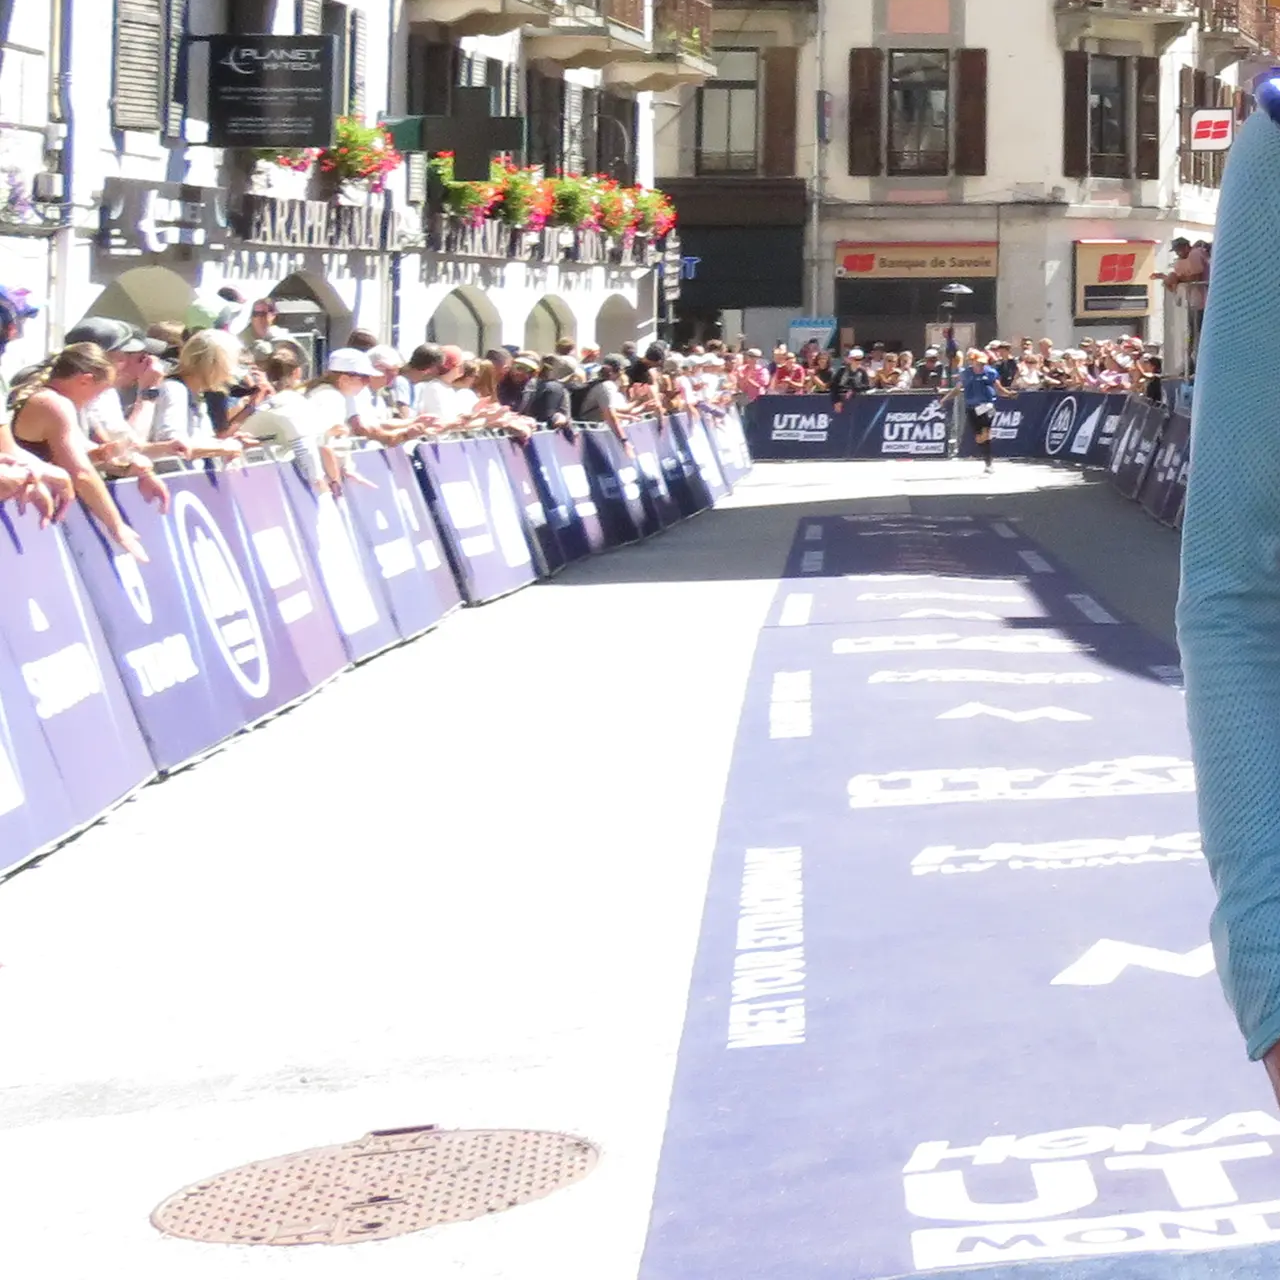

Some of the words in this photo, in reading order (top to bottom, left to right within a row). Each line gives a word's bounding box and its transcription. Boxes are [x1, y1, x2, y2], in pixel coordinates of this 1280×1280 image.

[240, 48, 321, 60] PLANET
[879, 257, 927, 270] Banque
[930, 256, 946, 268] de
[950, 256, 991, 268] Savoie
[773, 413, 829, 430] UTMB
[991, 411, 1021, 426] TMB
[883, 422, 945, 441] UTMB
[726, 998, 806, 1049] MEET
